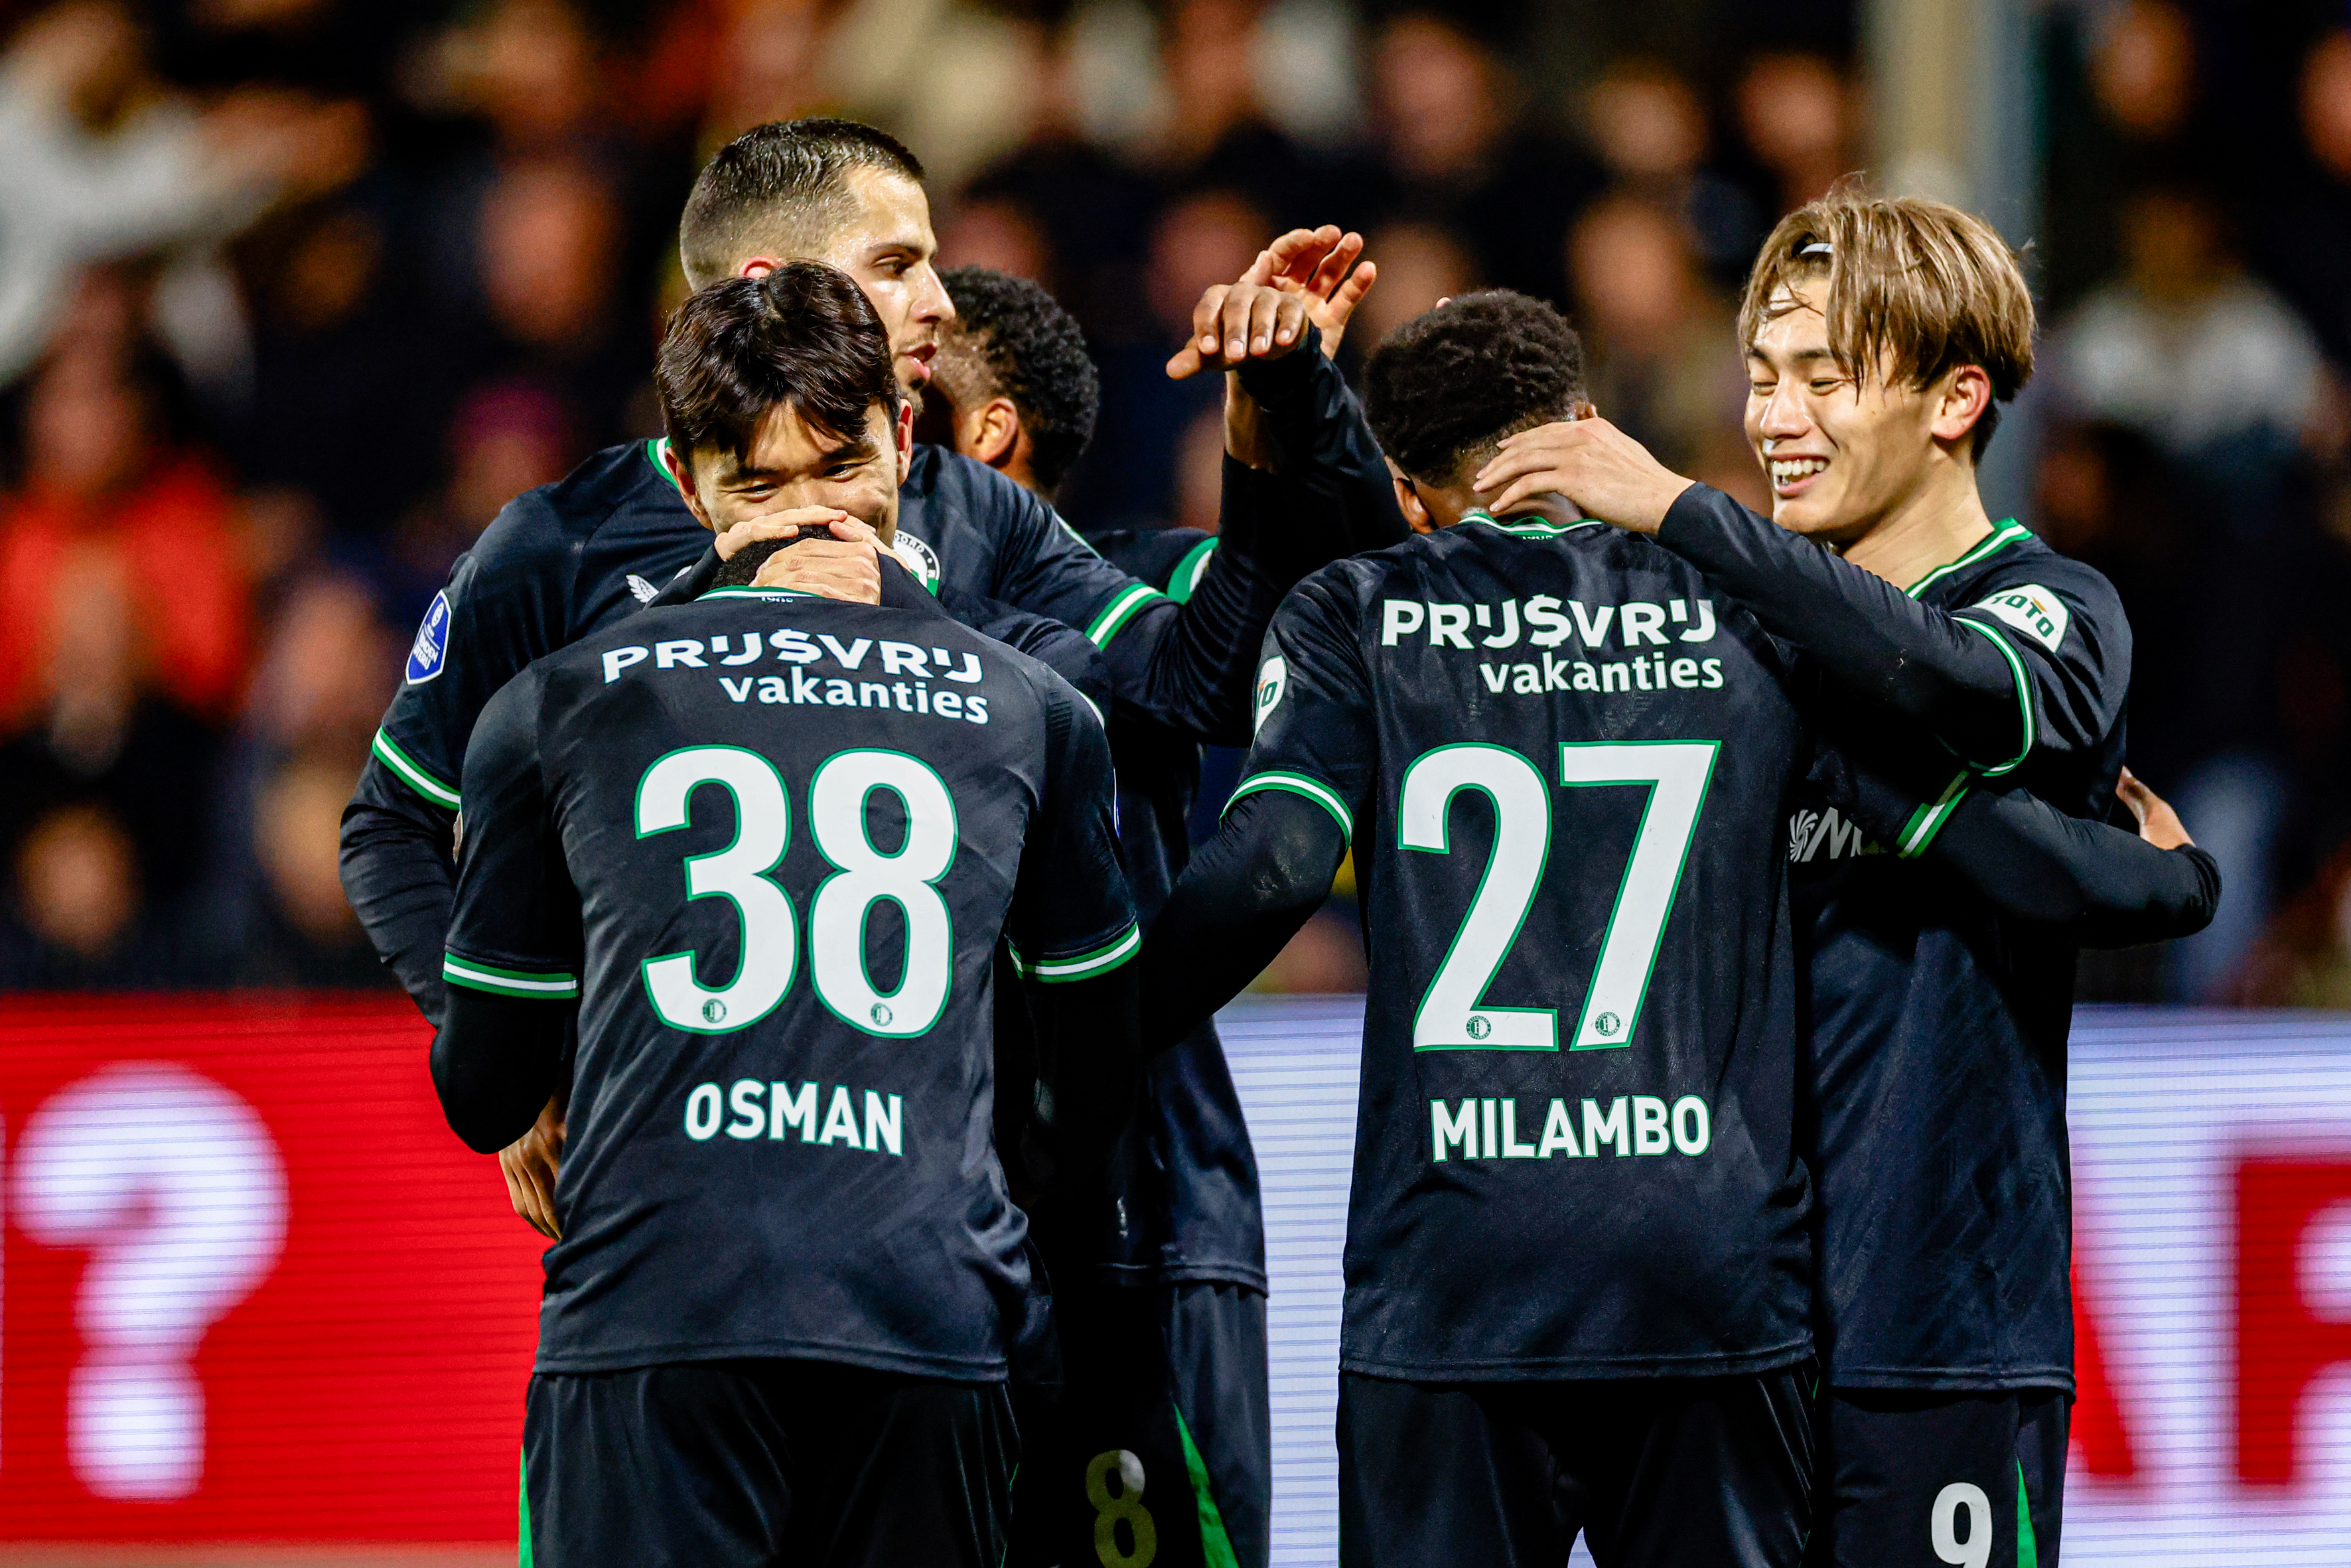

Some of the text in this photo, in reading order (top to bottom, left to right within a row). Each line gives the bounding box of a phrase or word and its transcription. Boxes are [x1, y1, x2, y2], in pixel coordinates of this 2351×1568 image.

[717, 664, 989, 725] vakanties
[1478, 650, 1725, 695] vakanties
[634, 743, 960, 1039] 38
[1397, 739, 1722, 1052] 27
[683, 1076, 904, 1157] OSMAN
[1430, 1094, 1711, 1163] MILAMBO
[1085, 1449, 1157, 1568] 8
[1931, 1482, 1992, 1568] 9
